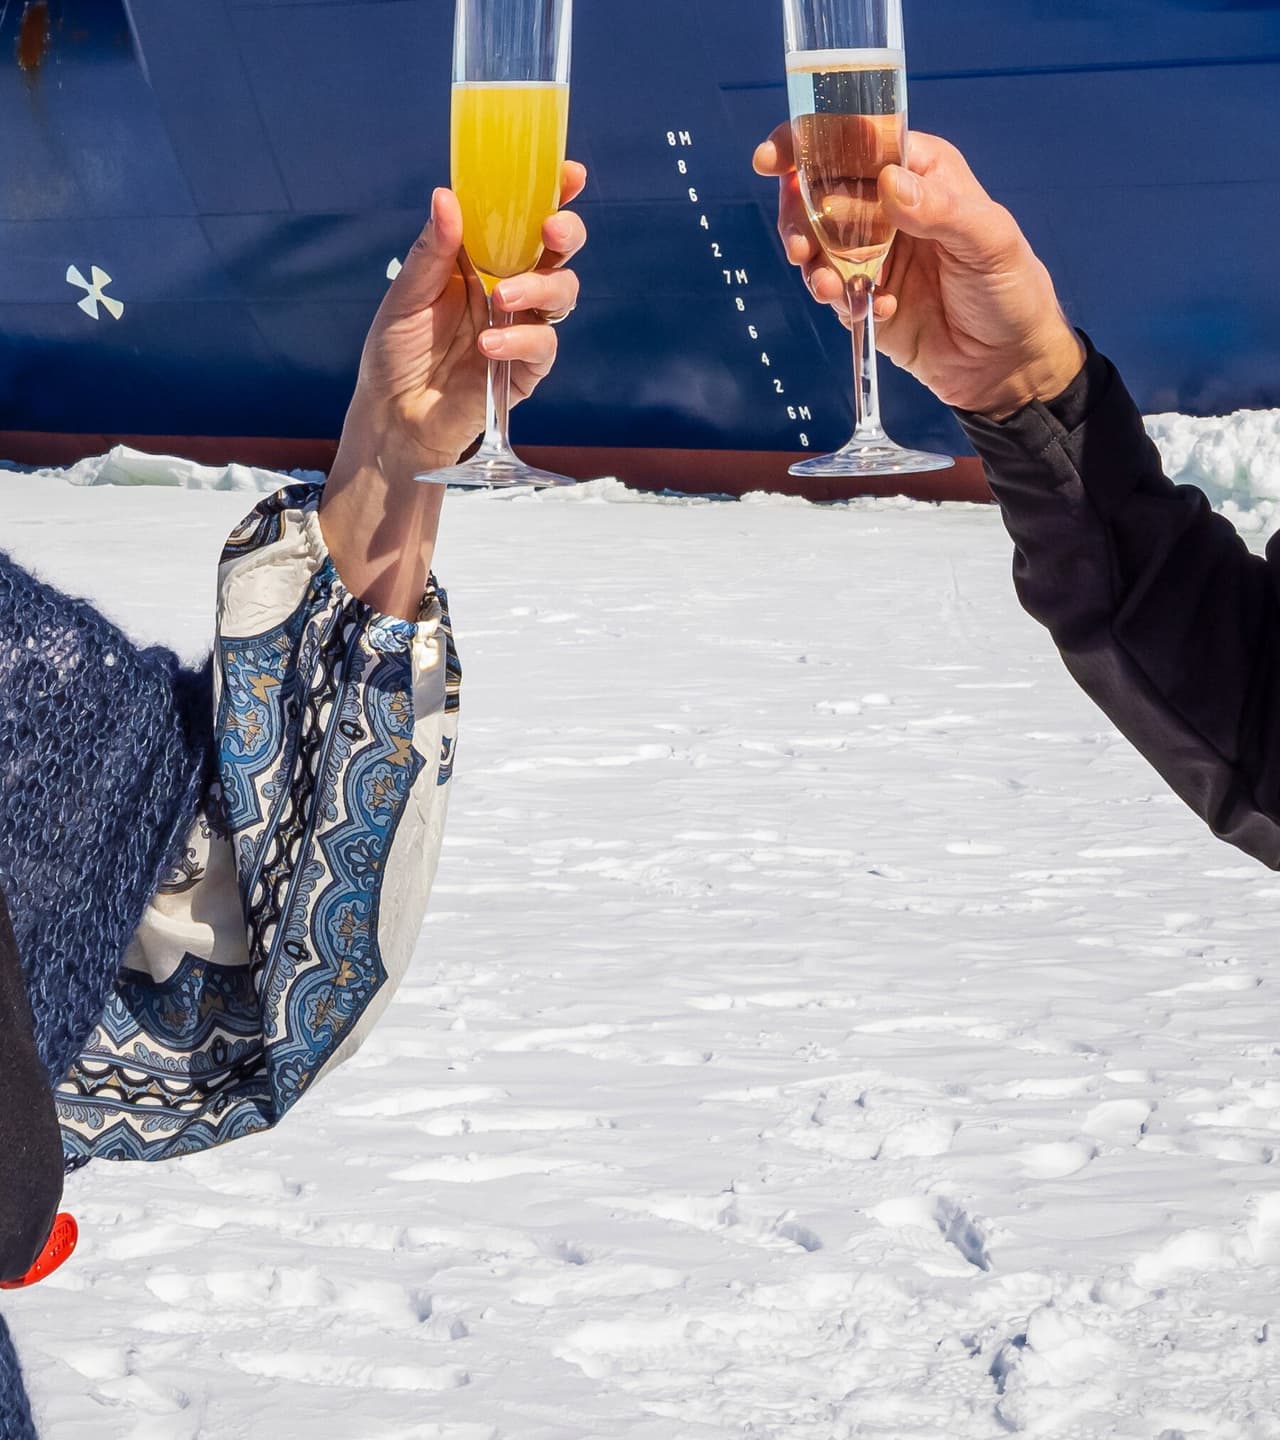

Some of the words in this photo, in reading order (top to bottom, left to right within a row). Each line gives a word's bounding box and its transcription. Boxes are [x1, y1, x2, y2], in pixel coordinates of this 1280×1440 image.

[667, 132, 676, 146] 8
[679, 131, 691, 146] M
[678, 160, 687, 174] 8
[688, 187, 698, 202] 6
[700, 215, 708, 230] 4
[712, 244, 722, 258] 2
[723, 271, 731, 284] 7
[735, 269, 748, 284] M
[735, 297, 745, 311] 8
[748, 325, 758, 339] 6
[761, 353, 770, 366] 4
[773, 380, 784, 393] 2
[787, 406, 796, 420] 6
[799, 406, 811, 420] M
[800, 433, 809, 447] 8
